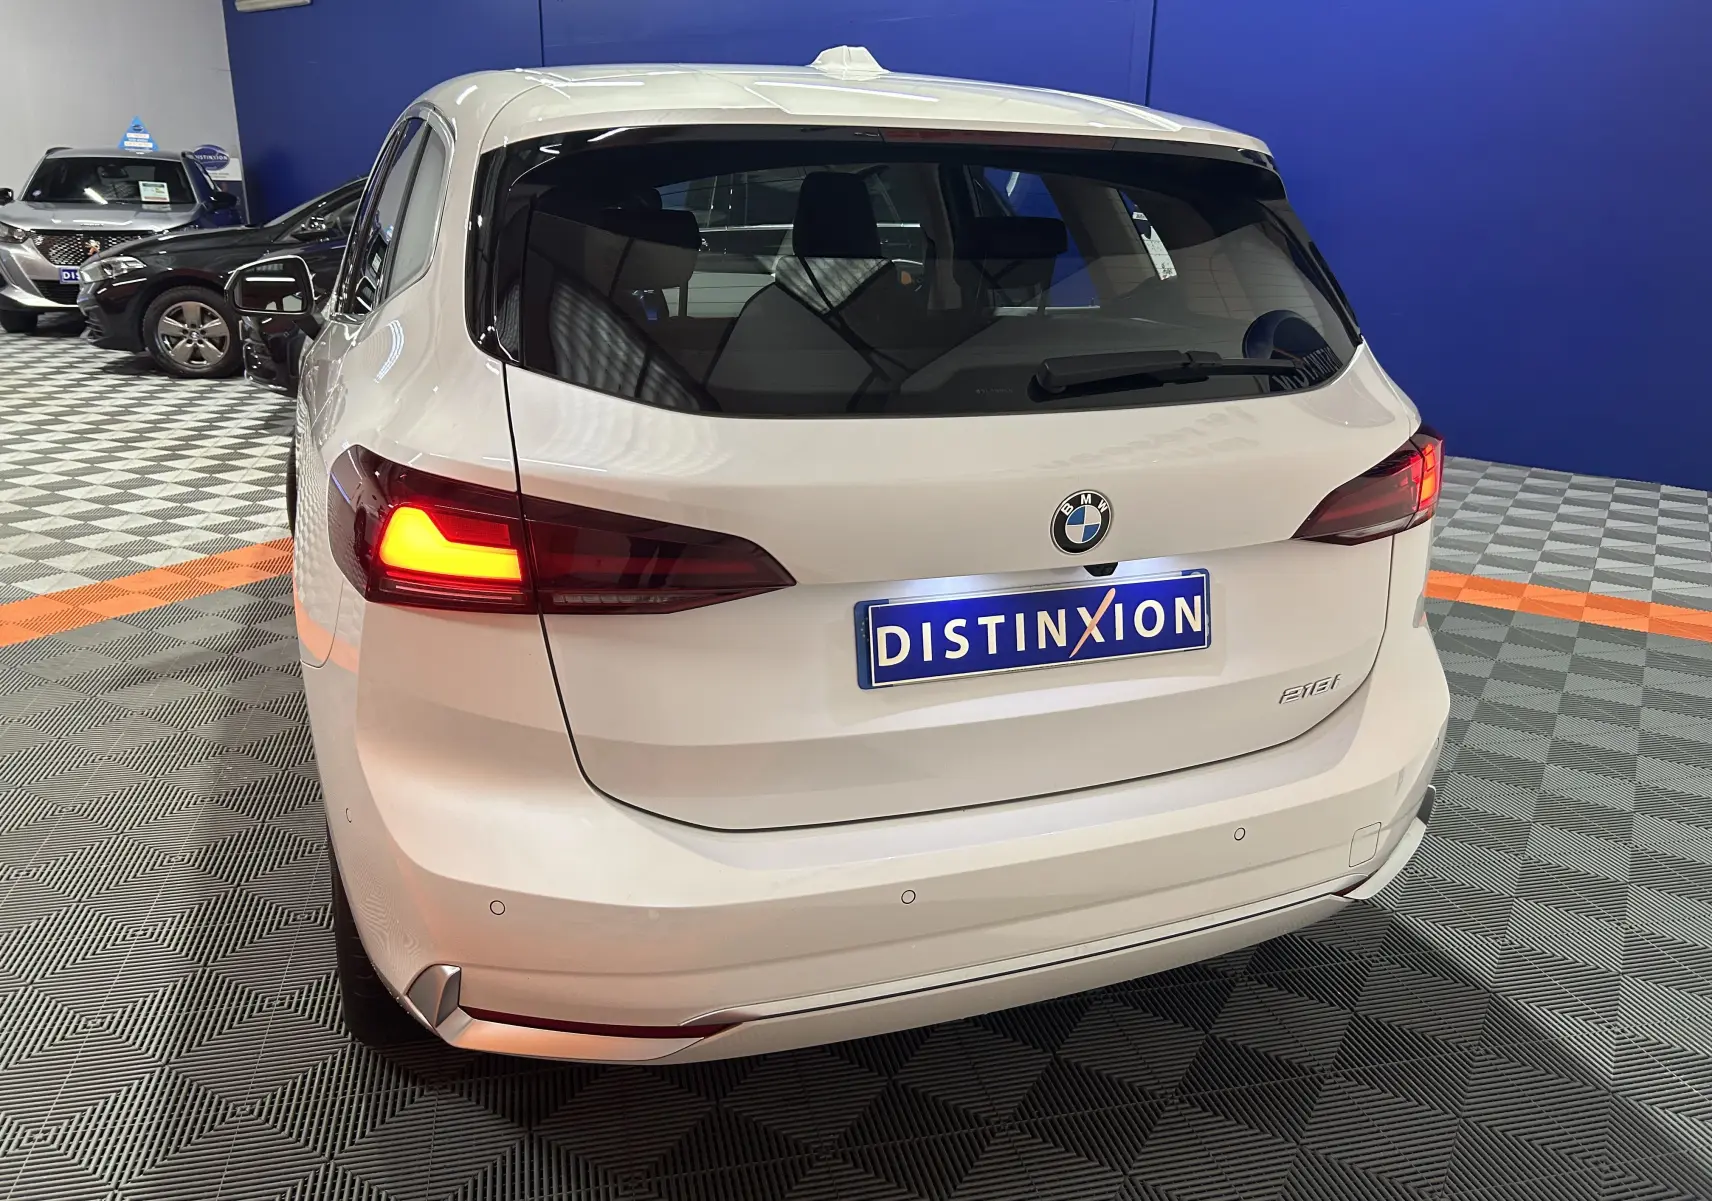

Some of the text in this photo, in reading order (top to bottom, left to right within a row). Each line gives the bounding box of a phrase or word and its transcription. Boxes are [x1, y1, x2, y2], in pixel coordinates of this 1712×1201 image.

[1060, 493, 1108, 516] BMW
[876, 588, 1202, 667] DISTINXION
[1279, 674, 1342, 704] 218i
